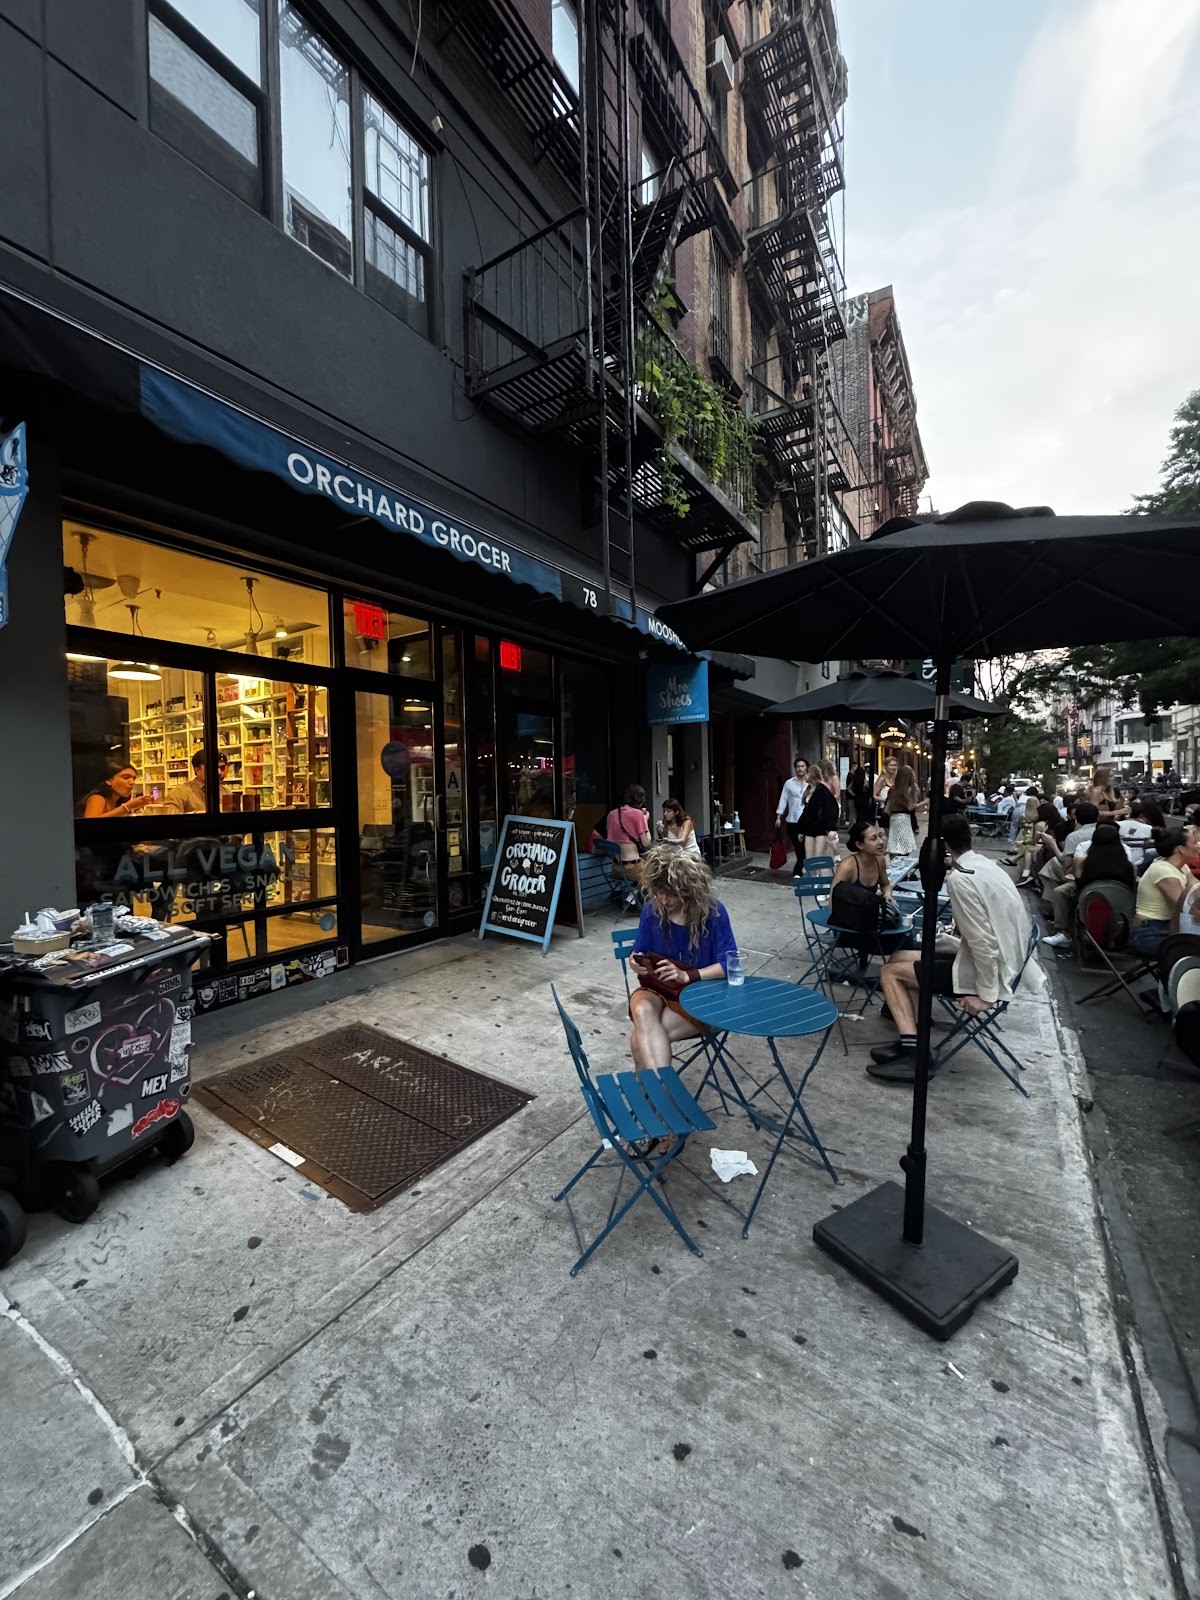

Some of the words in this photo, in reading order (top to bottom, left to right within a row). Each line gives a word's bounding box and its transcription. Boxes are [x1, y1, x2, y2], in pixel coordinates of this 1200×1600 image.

[287, 452, 425, 535] ORCHARD
[431, 520, 512, 573] GROCER
[582, 587, 598, 608] 78
[666, 675, 689, 695] Moo
[660, 691, 693, 709] Shoes
[447, 771, 459, 789] A
[114, 850, 188, 880] ALL
[197, 842, 297, 875] VEGAN
[506, 843, 557, 865] ORCHARD
[100, 877, 232, 907] SANDWICHES
[501, 866, 547, 895] GROCER
[167, 896, 218, 918] SOFT
[222, 890, 275, 910] SERVE
[141, 1073, 170, 1099] MEX
[68, 1098, 99, 1128] SHEILA
[73, 1103, 103, 1133] SUPER
[82, 1111, 103, 1135] STAR
